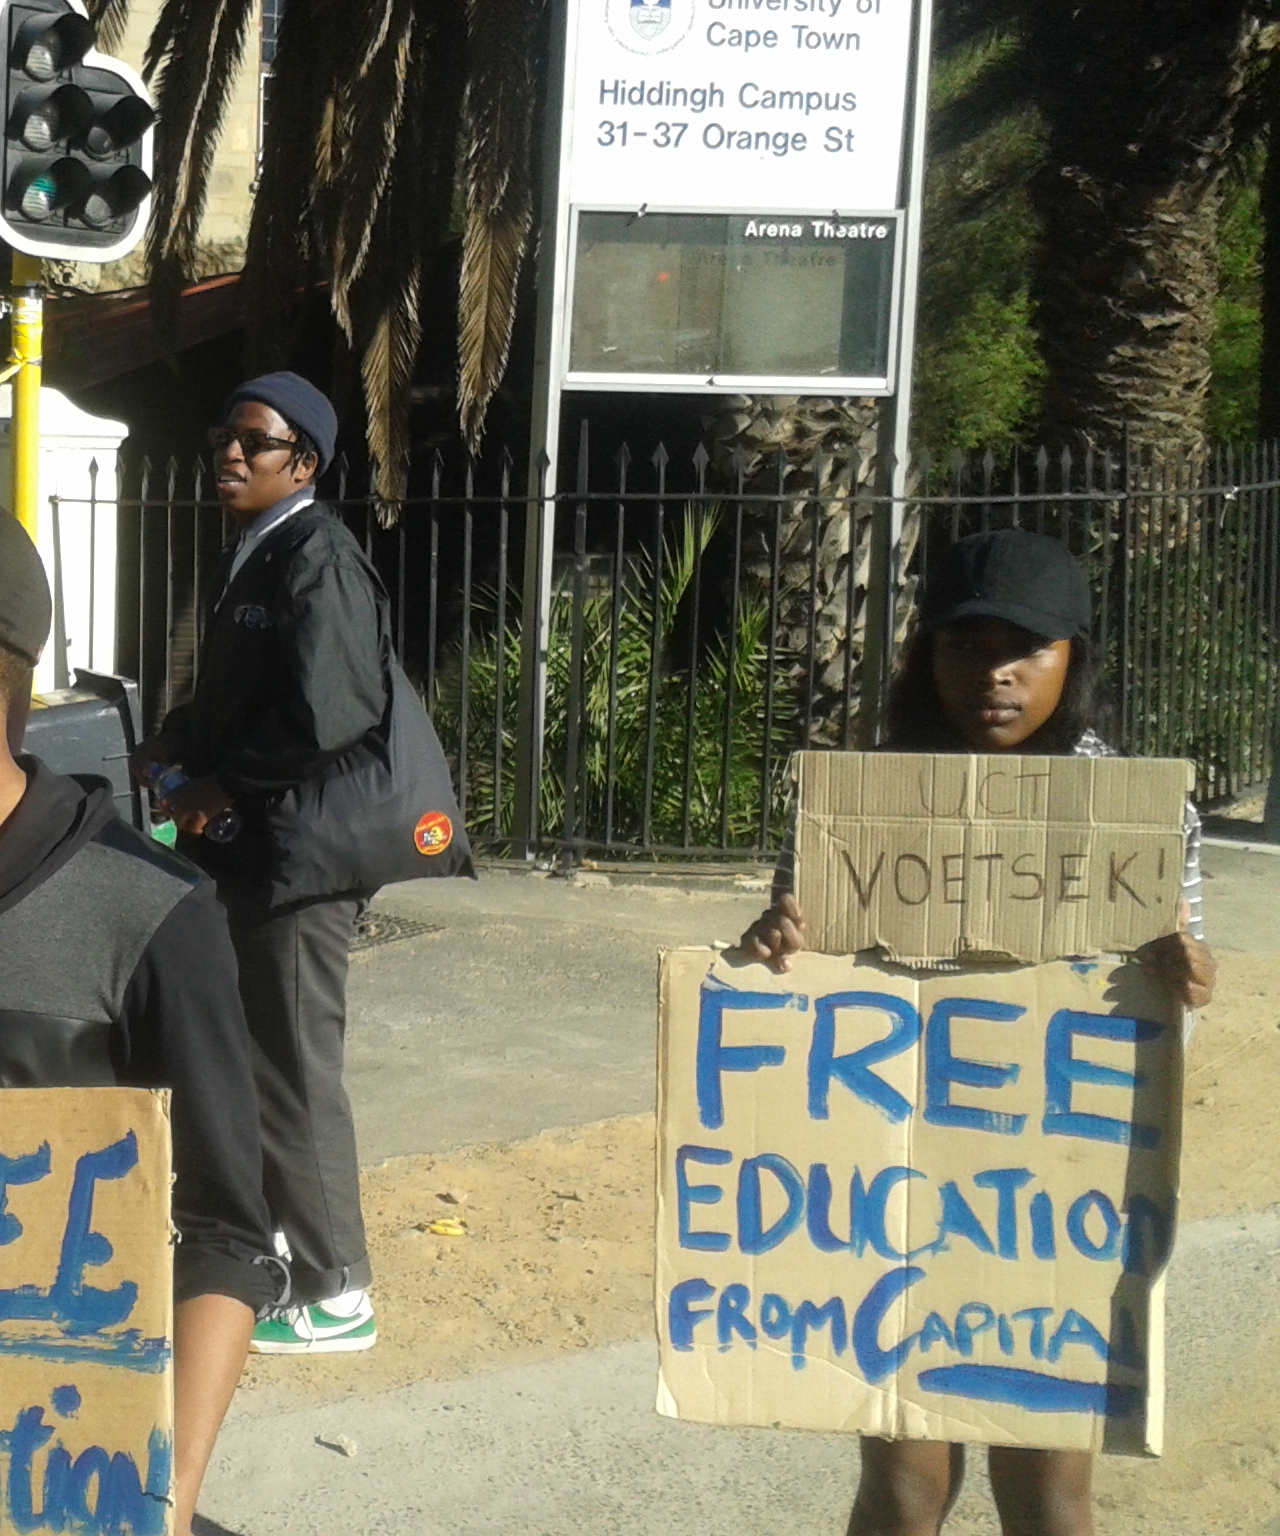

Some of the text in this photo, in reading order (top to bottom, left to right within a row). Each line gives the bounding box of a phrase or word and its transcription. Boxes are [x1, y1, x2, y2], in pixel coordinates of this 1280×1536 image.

[706, 21, 861, 53] Cape Town
[598, 79, 857, 116] Hiddingh Campus
[596, 121, 855, 157] 31-37 Orange St
[744, 220, 888, 240] Arena Theatre
[920, 771, 1051, 820] UCT
[843, 848, 1166, 911] VOETSEK!
[696, 986, 1164, 1150] FREE
[675, 1145, 1172, 1273] EDUCATION
[669, 1277, 848, 1371] FROM
